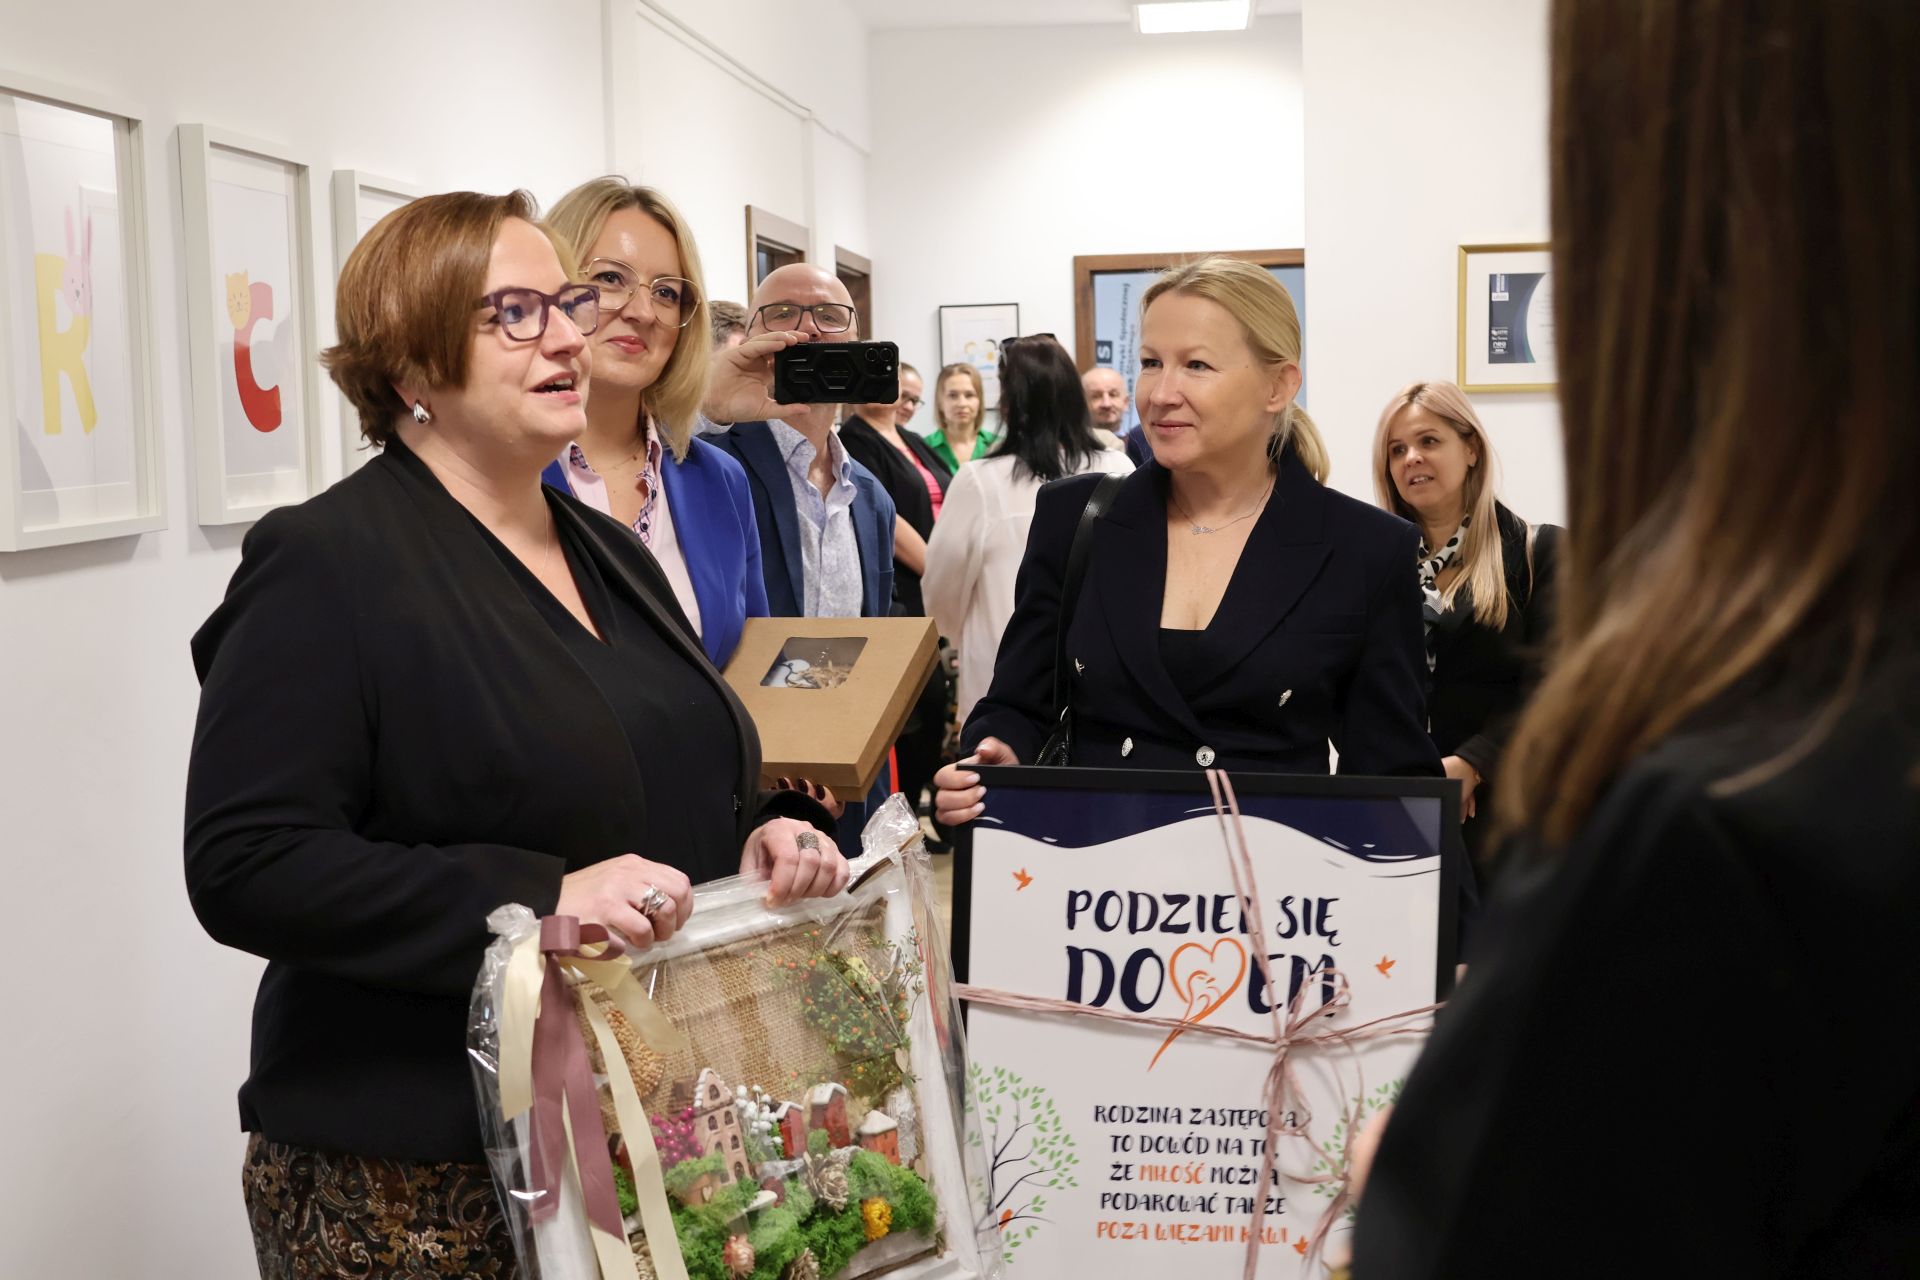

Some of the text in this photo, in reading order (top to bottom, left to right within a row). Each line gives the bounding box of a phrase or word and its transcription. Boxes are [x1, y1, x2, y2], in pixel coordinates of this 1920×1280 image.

[1276, 895, 1342, 947] SIĘ
[1094, 1105, 1297, 1130] RODZINA ZASTĘPCA
[1110, 1134, 1131, 1153] TO
[1140, 1131, 1210, 1155] DOWÓD
[1216, 1137, 1243, 1156] NA
[1109, 1161, 1133, 1182] ŻE
[1139, 1164, 1203, 1185] MIŁOŚĆ
[1101, 1192, 1218, 1214] PODAROWAĆ
[1096, 1221, 1150, 1241] POZA
[1155, 1223, 1235, 1246] WIĘZAMI
